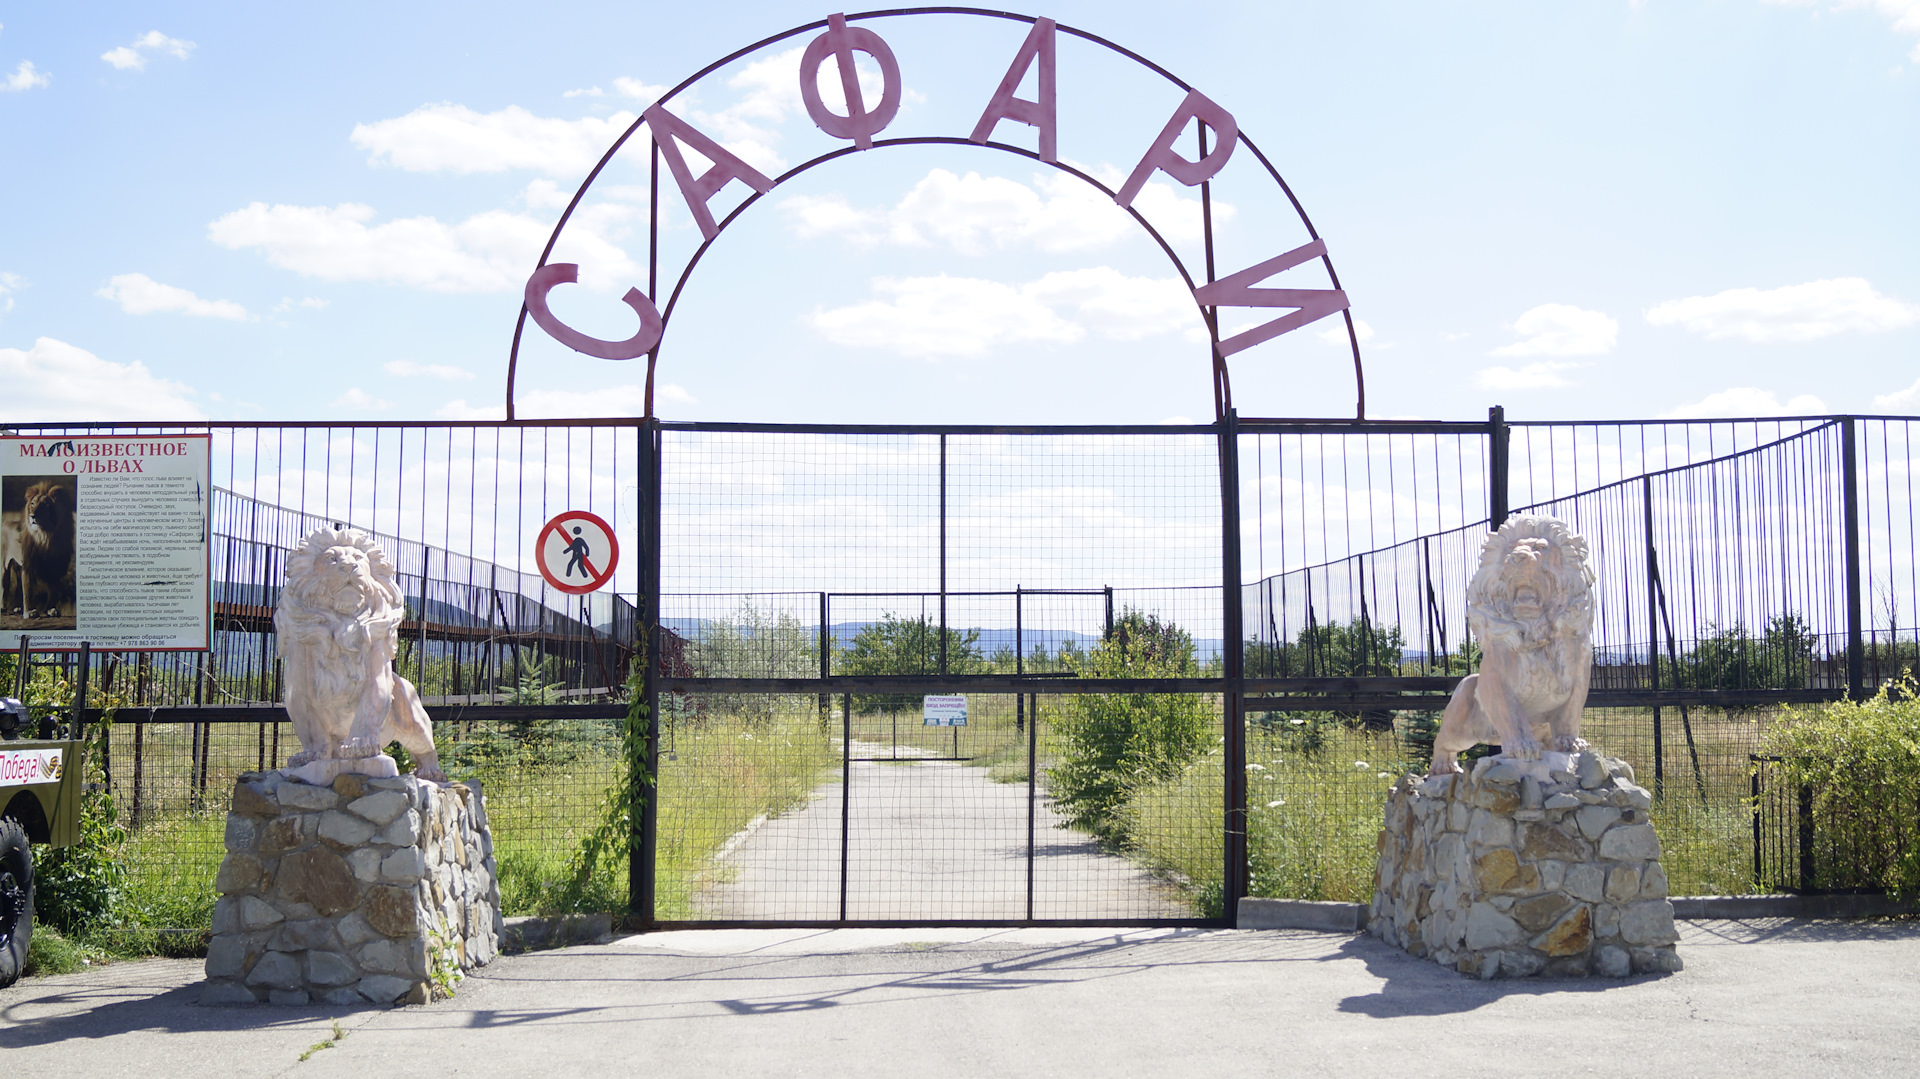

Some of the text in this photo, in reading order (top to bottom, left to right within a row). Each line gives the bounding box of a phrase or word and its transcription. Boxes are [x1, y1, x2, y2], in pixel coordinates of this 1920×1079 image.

[525, 12, 1350, 360] САФАРИ
[63, 458, 144, 474] О ЛЬВАХ
